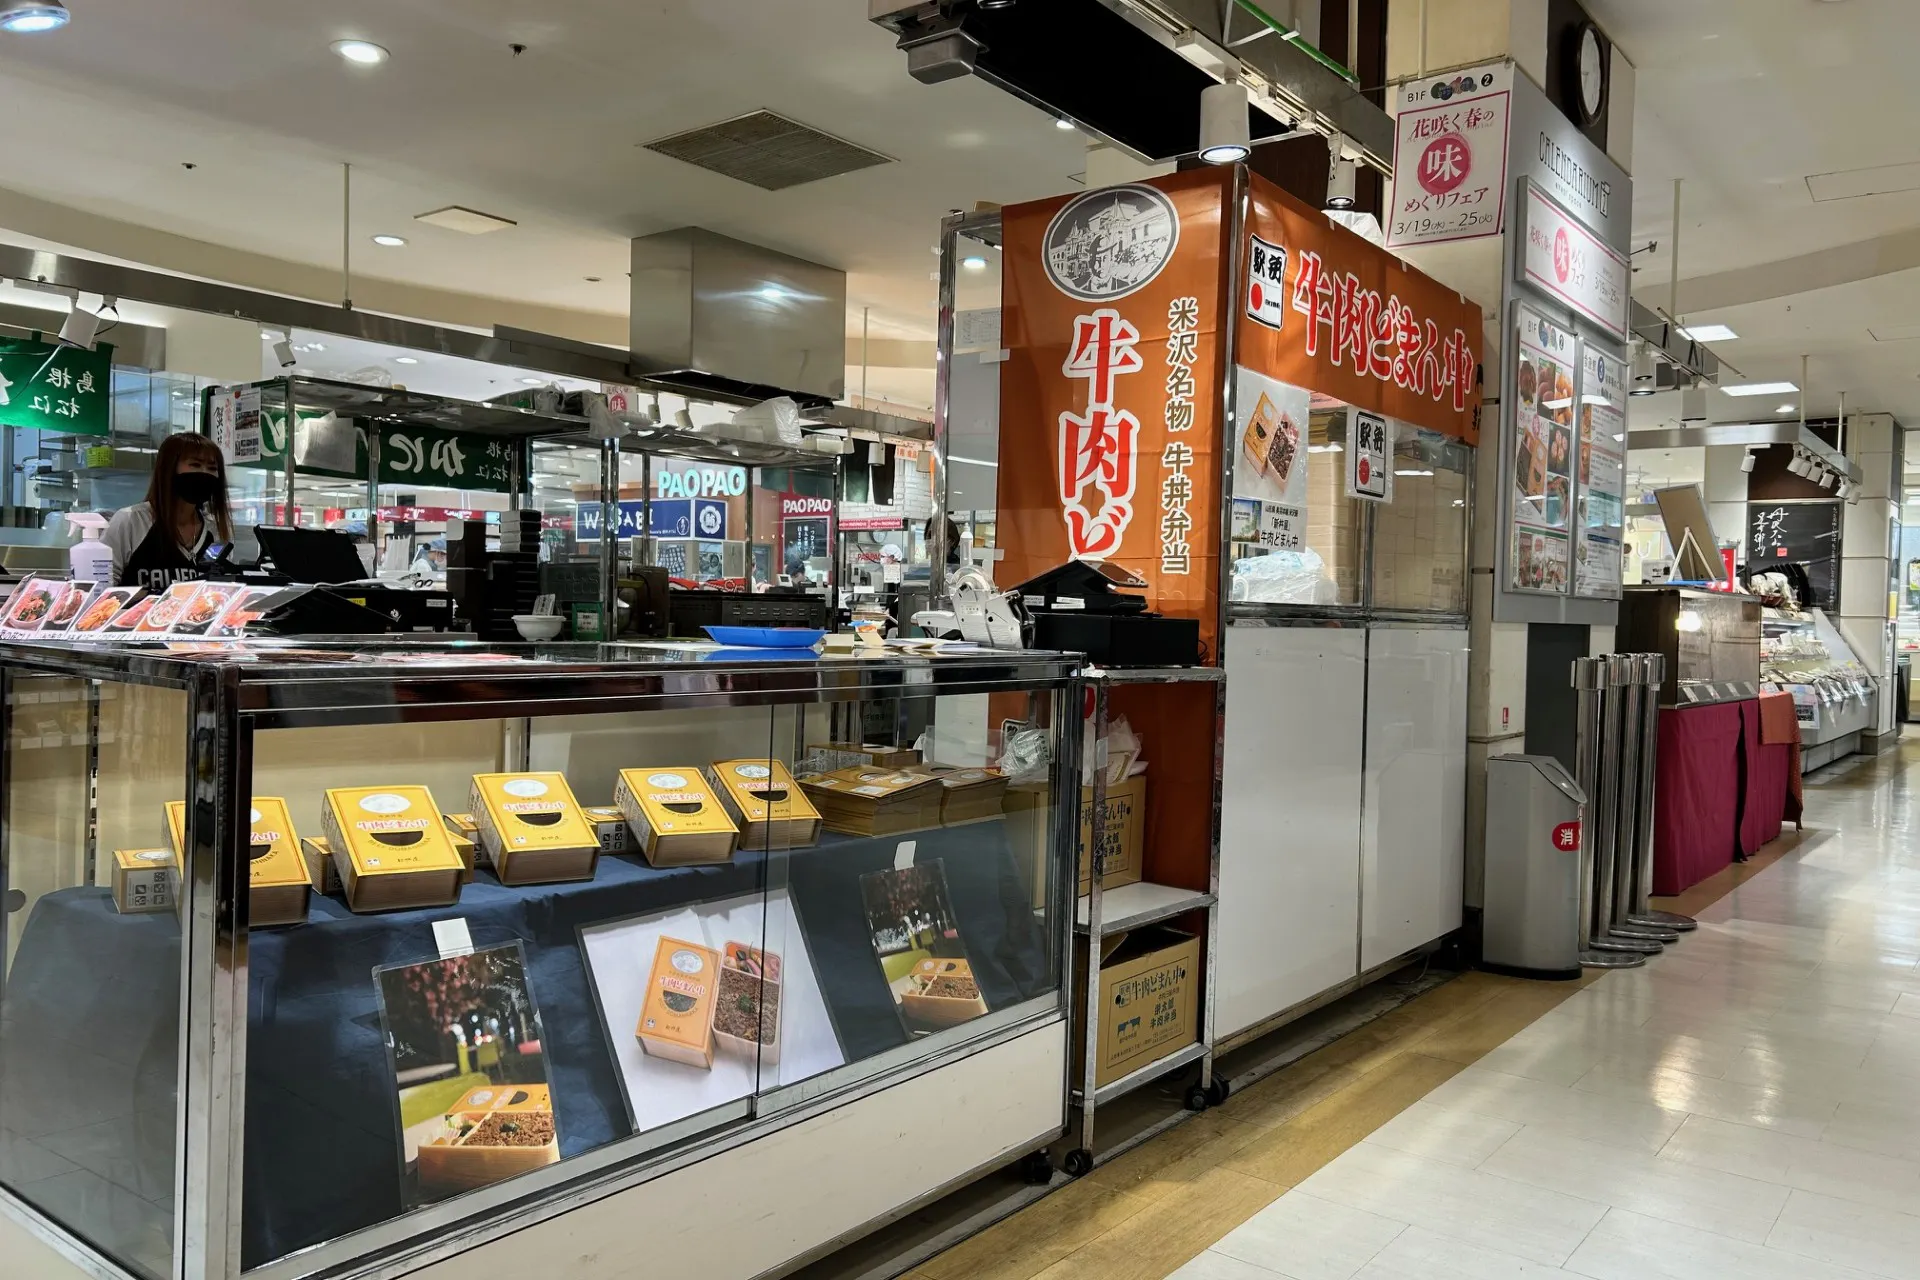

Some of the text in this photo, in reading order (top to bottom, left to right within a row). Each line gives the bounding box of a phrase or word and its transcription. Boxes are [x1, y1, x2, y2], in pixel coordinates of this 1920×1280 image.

[1407, 91, 1427, 102] B1F
[1411, 107, 1494, 139] 花咲く春の
[1427, 144, 1462, 183] 味
[1404, 187, 1489, 213] めぐりフェア
[1556, 237, 1568, 272] 味
[1292, 250, 1474, 413] 牛肉どまん中
[1161, 298, 1198, 575] 米沢名物 牛丼弁当
[584, 504, 653, 534] WSABI
[783, 498, 831, 514] PAOPAO
[1261, 531, 1299, 548] 牛肉どまん中
[1131, 965, 1183, 1001] 牛肉どまん中
